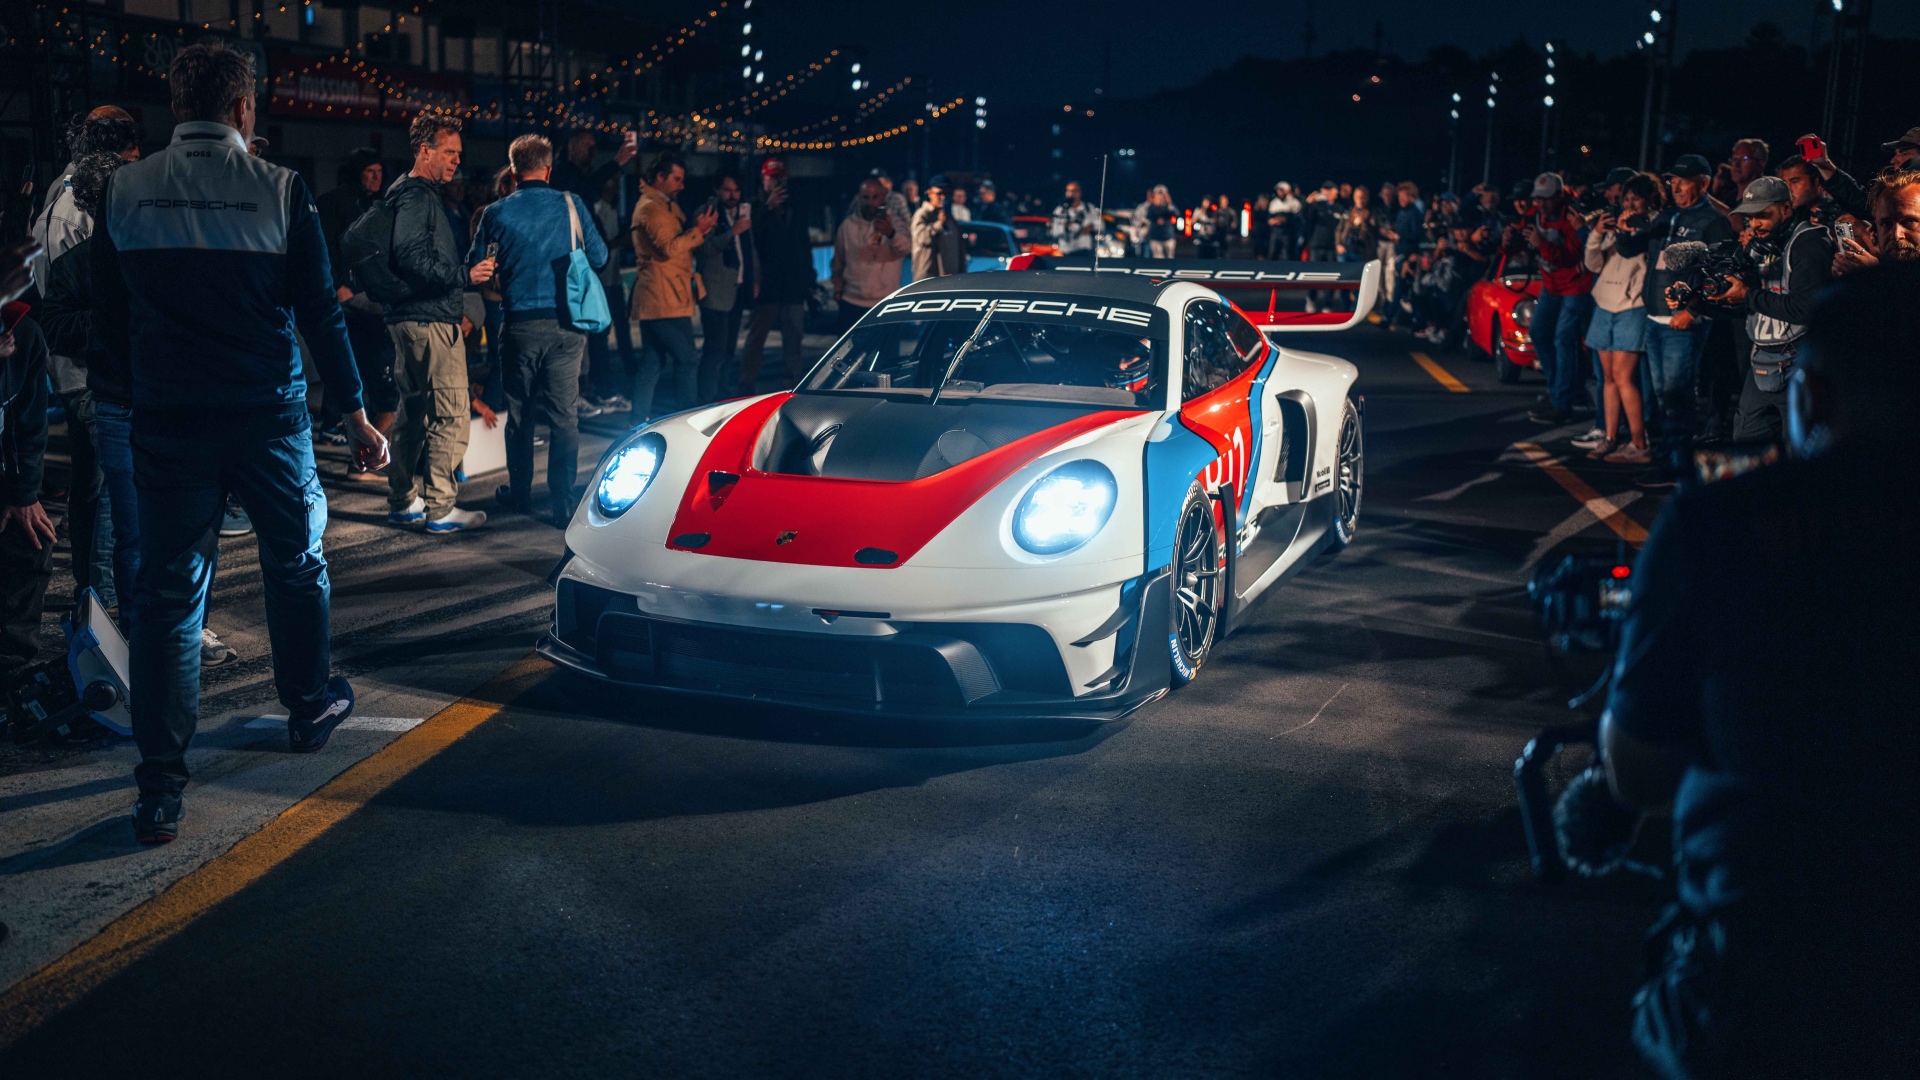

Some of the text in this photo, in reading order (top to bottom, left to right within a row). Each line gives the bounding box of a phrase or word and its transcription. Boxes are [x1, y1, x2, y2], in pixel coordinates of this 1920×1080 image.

[186, 150, 212, 158] BOSS
[138, 199, 258, 212] PORSCHE
[876, 299, 1152, 327] PORSCHE
[1170, 638, 1191, 678] MICHELIN
